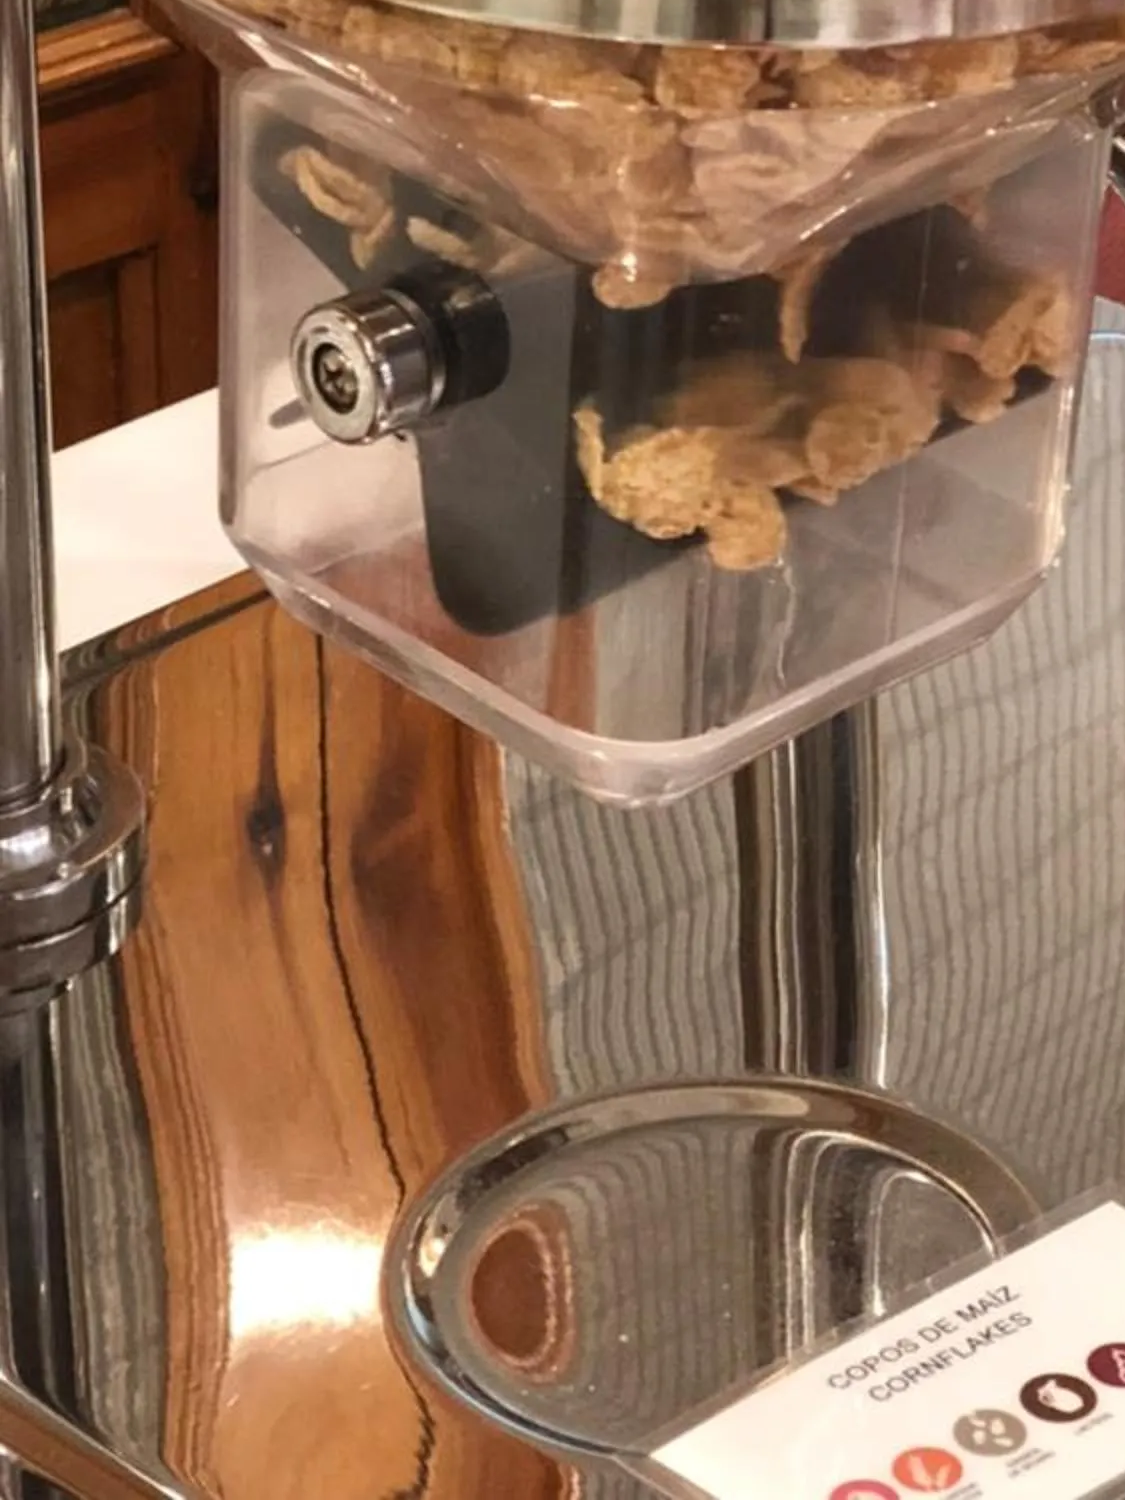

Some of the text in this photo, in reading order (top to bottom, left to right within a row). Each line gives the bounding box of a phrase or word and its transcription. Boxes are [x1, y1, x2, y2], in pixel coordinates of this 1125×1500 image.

[827, 1337, 920, 1390] COPOS
[917, 1317, 960, 1343] DE
[868, 1311, 1034, 1402] CORNFLAKES
